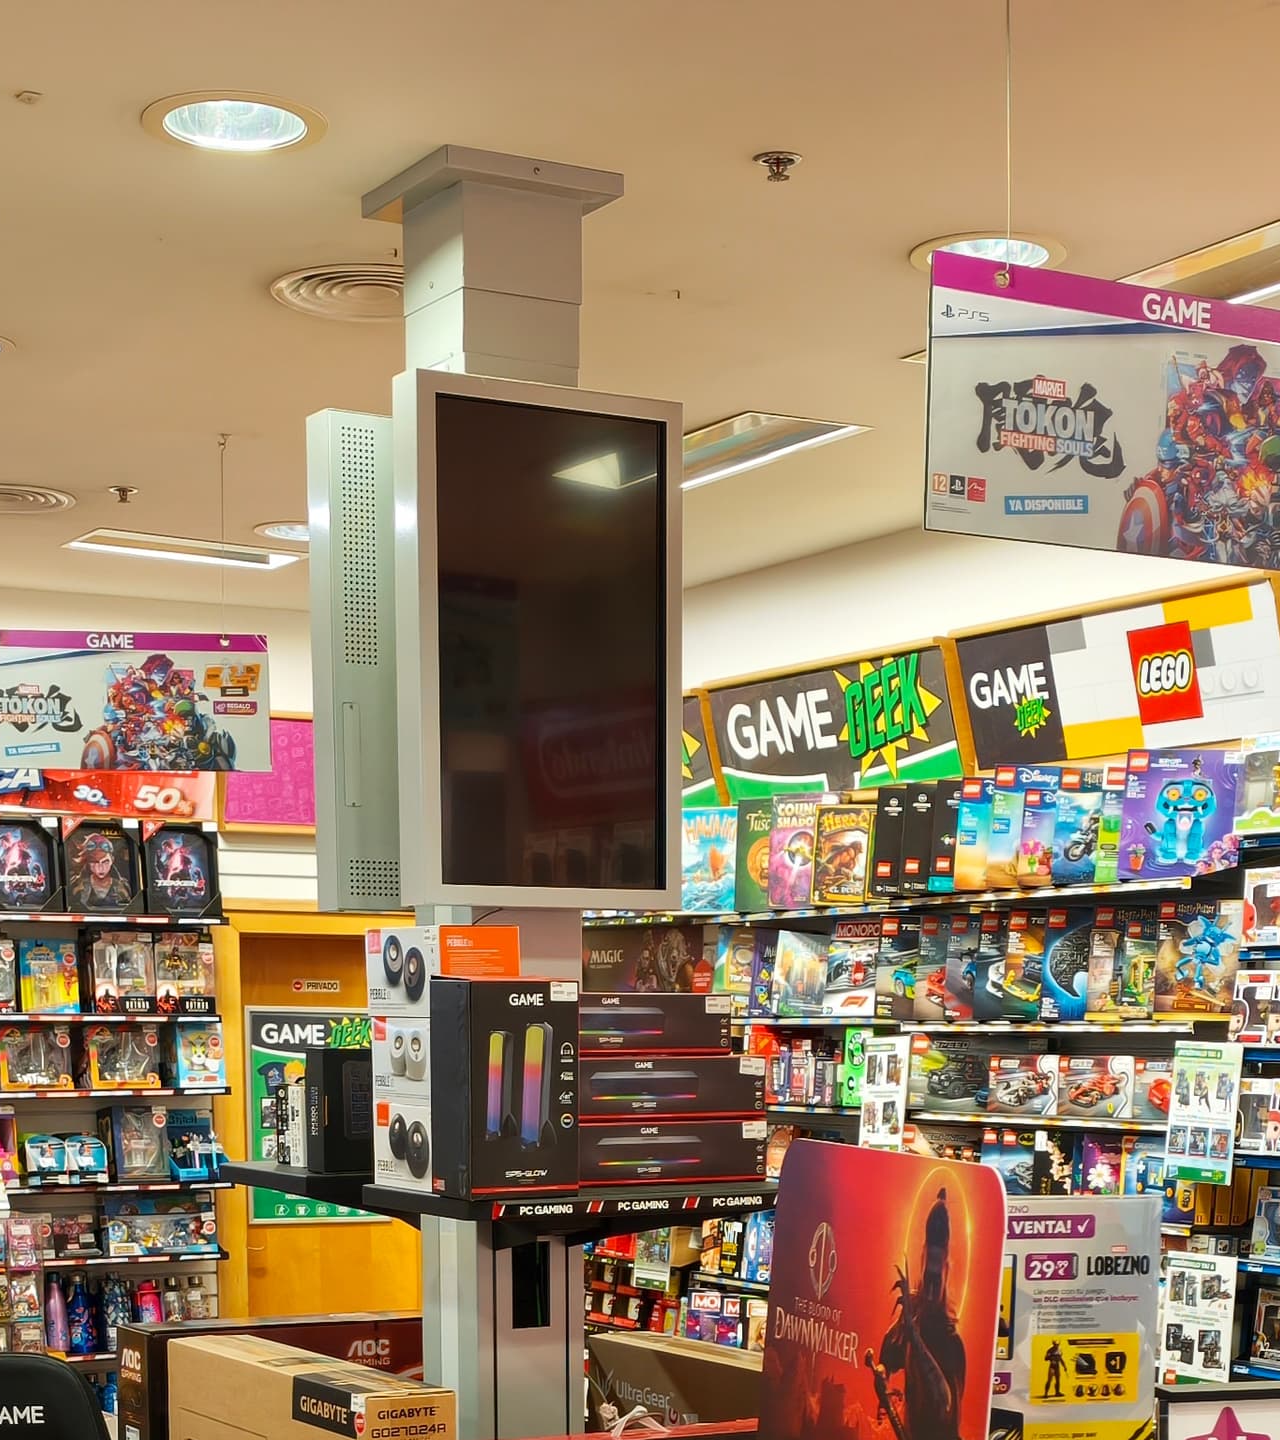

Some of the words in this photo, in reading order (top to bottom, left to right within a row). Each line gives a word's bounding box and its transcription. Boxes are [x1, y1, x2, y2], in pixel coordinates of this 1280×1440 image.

[958, 308, 989, 322] PS5
[1142, 293, 1212, 330] GAME
[1034, 379, 1065, 397] MARVEL
[1005, 400, 1095, 441] TOKON
[1000, 433, 1055, 453] FIGHTING
[1056, 439, 1093, 458] SOULS
[1008, 499, 1023, 511] YA
[1024, 497, 1084, 512] DISPONIBLE
[86, 633, 134, 649] GAME
[969, 662, 1049, 710] GAME
[1137, 651, 1193, 697] LEGO
[0, 695, 61, 716] TOKON
[726, 687, 839, 759] GAME
[842, 652, 928, 758] GEEK
[1014, 695, 1046, 733] GEEK
[133, 785, 194, 815] 50%
[591, 949, 624, 964] MAGIC
[305, 981, 339, 991] PRIVADO
[370, 988, 387, 1000] PEBBLE
[508, 993, 544, 1007] GAME
[601, 997, 620, 1005] GAME
[261, 1023, 325, 1045] GAME
[520, 1205, 533, 1216] PC
[534, 1204, 573, 1215] GAMING
[1012, 1219, 1072, 1235] VENTA!
[1087, 1254, 1150, 1277] LOBEZNO
[774, 1305, 860, 1368] DAWNWALKER
[346, 1338, 391, 1357] AOC
[615, 1380, 672, 1410] UltraGear
[376, 1405, 437, 1421] GIGABYTE
